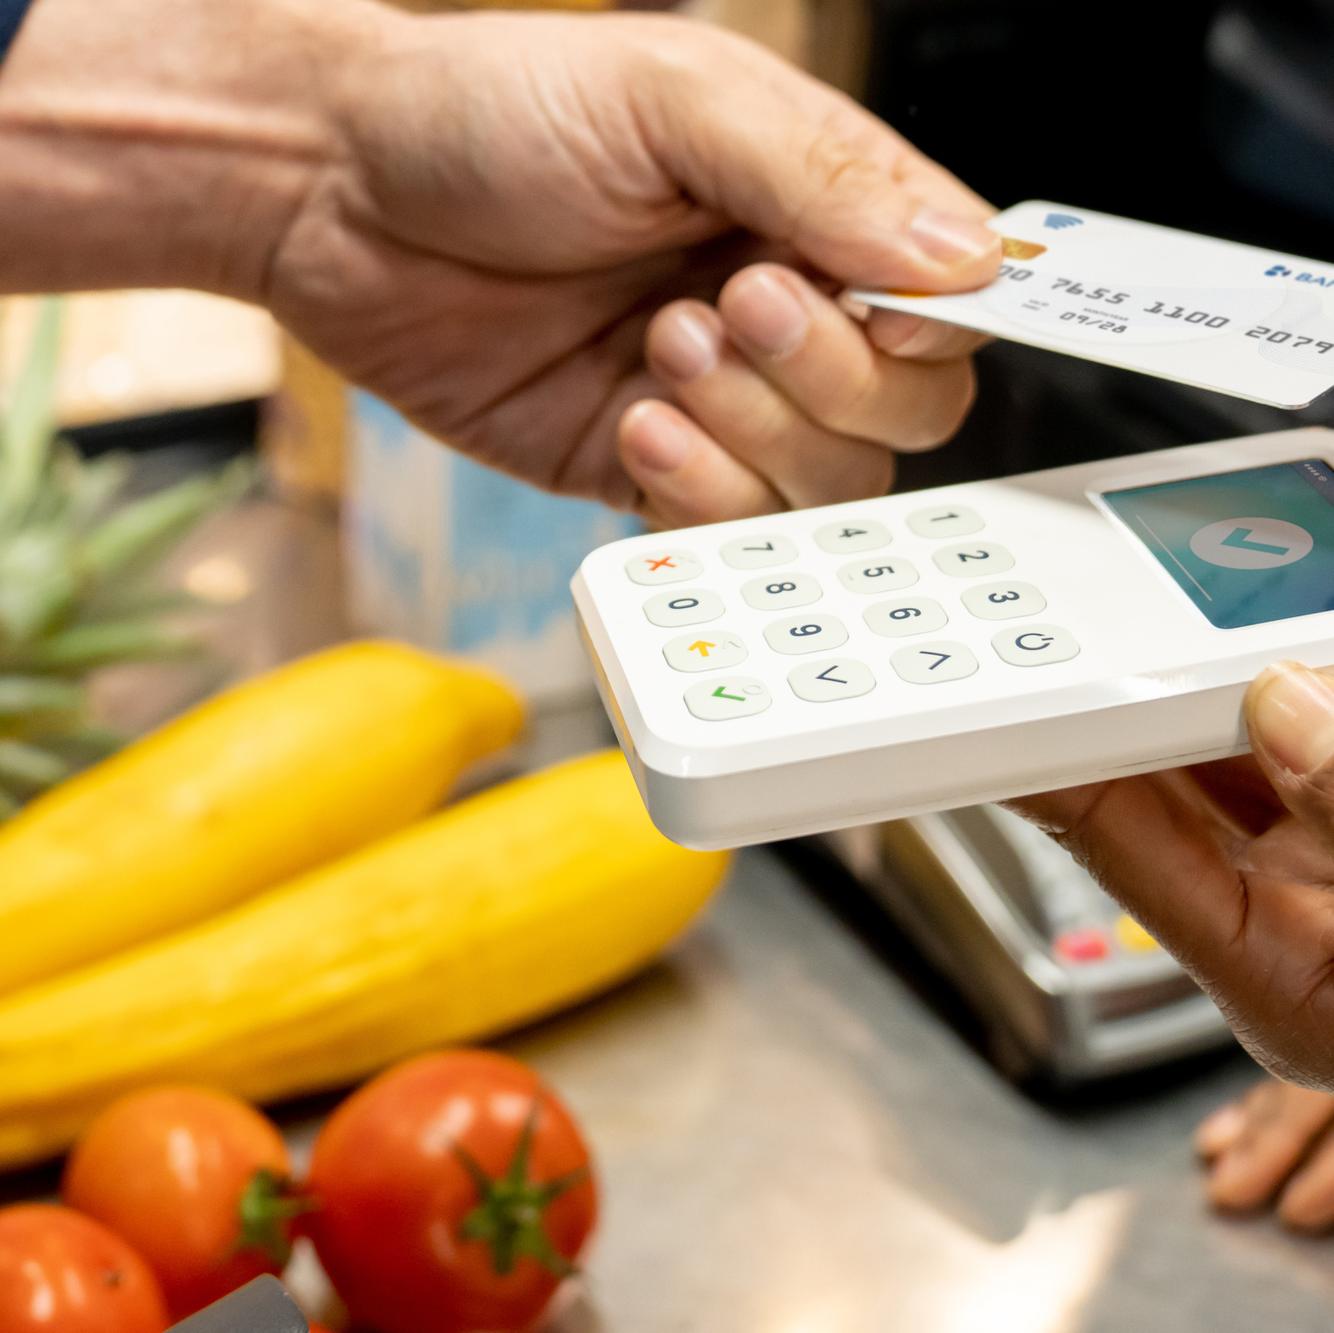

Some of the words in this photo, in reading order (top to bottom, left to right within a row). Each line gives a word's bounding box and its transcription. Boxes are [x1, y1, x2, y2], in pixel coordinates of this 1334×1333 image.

[1050, 277, 1131, 305] 7655
[1142, 301, 1231, 329] 1100
[1059, 311, 1128, 334] 09/28
[929, 512, 959, 523] 1
[838, 527, 869, 539] 4
[742, 541, 775, 552] 7
[956, 549, 990, 563] 2
[862, 565, 895, 578] 5
[765, 581, 797, 595] 8
[668, 597, 700, 611] 0
[987, 590, 1021, 604] 3
[888, 607, 922, 620] 6
[789, 623, 823, 638] 9
